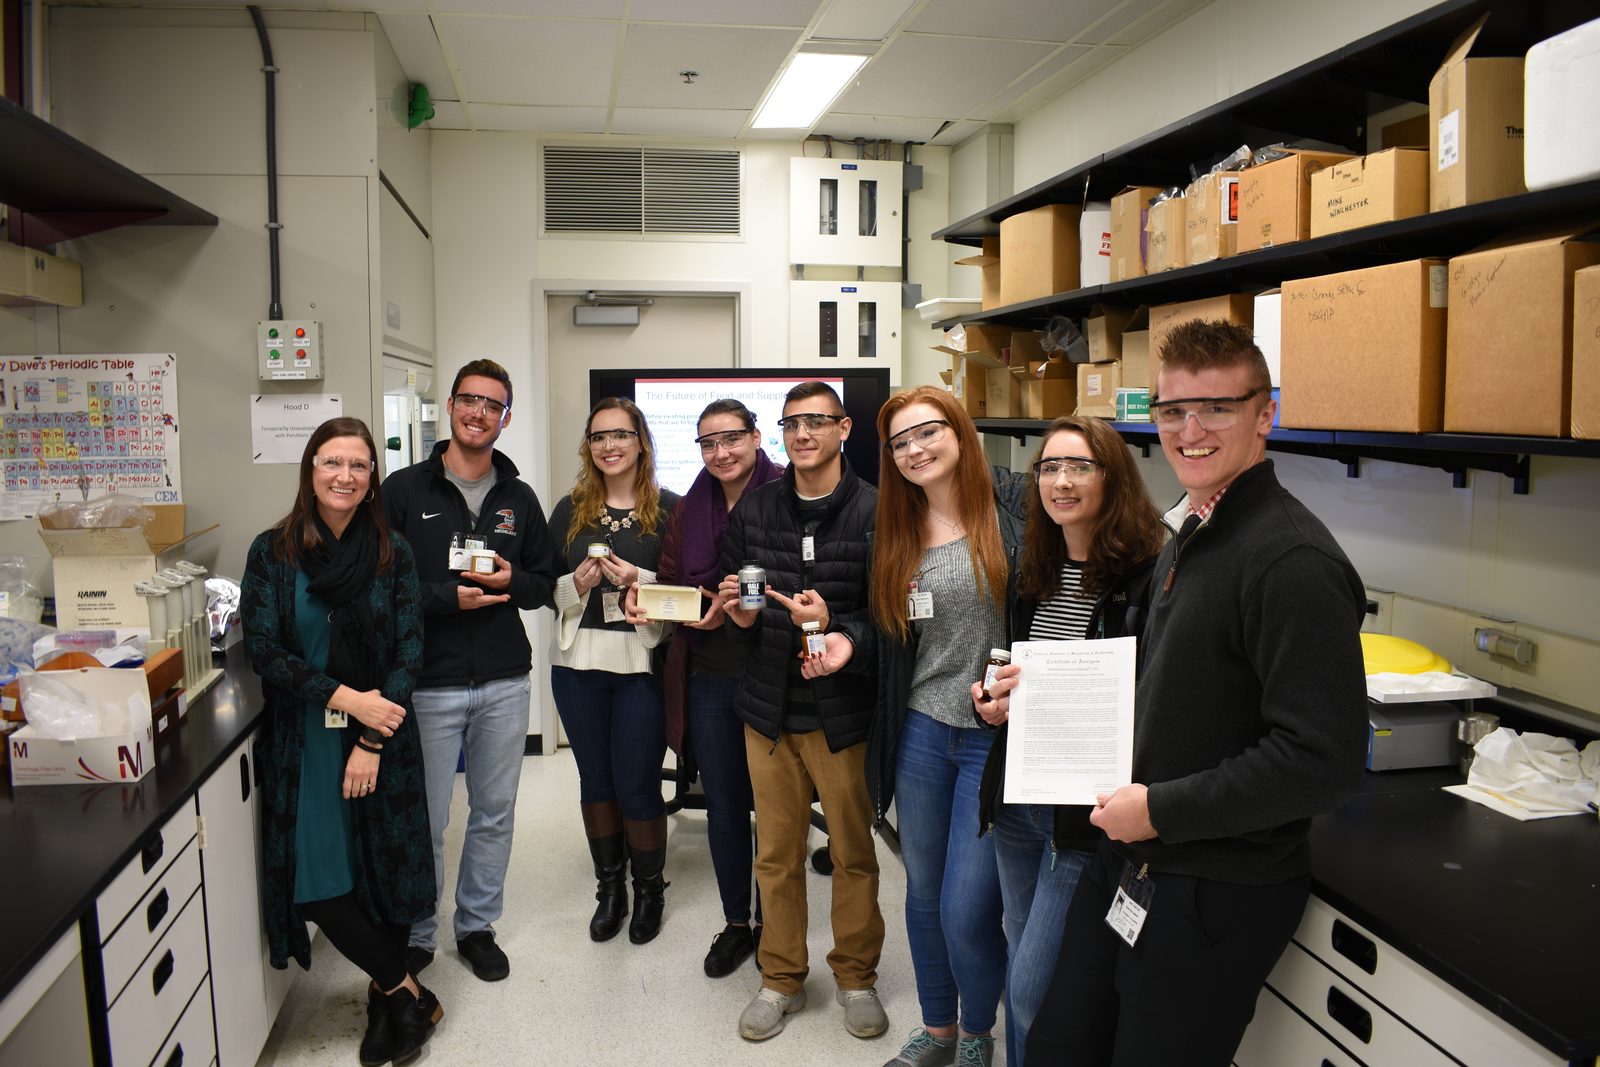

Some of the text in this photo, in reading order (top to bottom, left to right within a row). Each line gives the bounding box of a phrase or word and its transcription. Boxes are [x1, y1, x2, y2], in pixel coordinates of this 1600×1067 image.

[1328, 197, 1342, 208] MIKE
[1330, 198, 1368, 218] WINCHESTER
[10, 360, 46, 372] Dave's
[50, 360, 98, 370] Periodic
[102, 359, 134, 370] Table
[646, 391, 663, 400] The
[666, 392, 696, 400] Future
[698, 391, 707, 400] of
[710, 391, 734, 400] Food
[737, 391, 754, 400] and
[154, 491, 178, 502] CEM
[78, 590, 107, 599] RAININ
[13, 741, 28, 759] M
